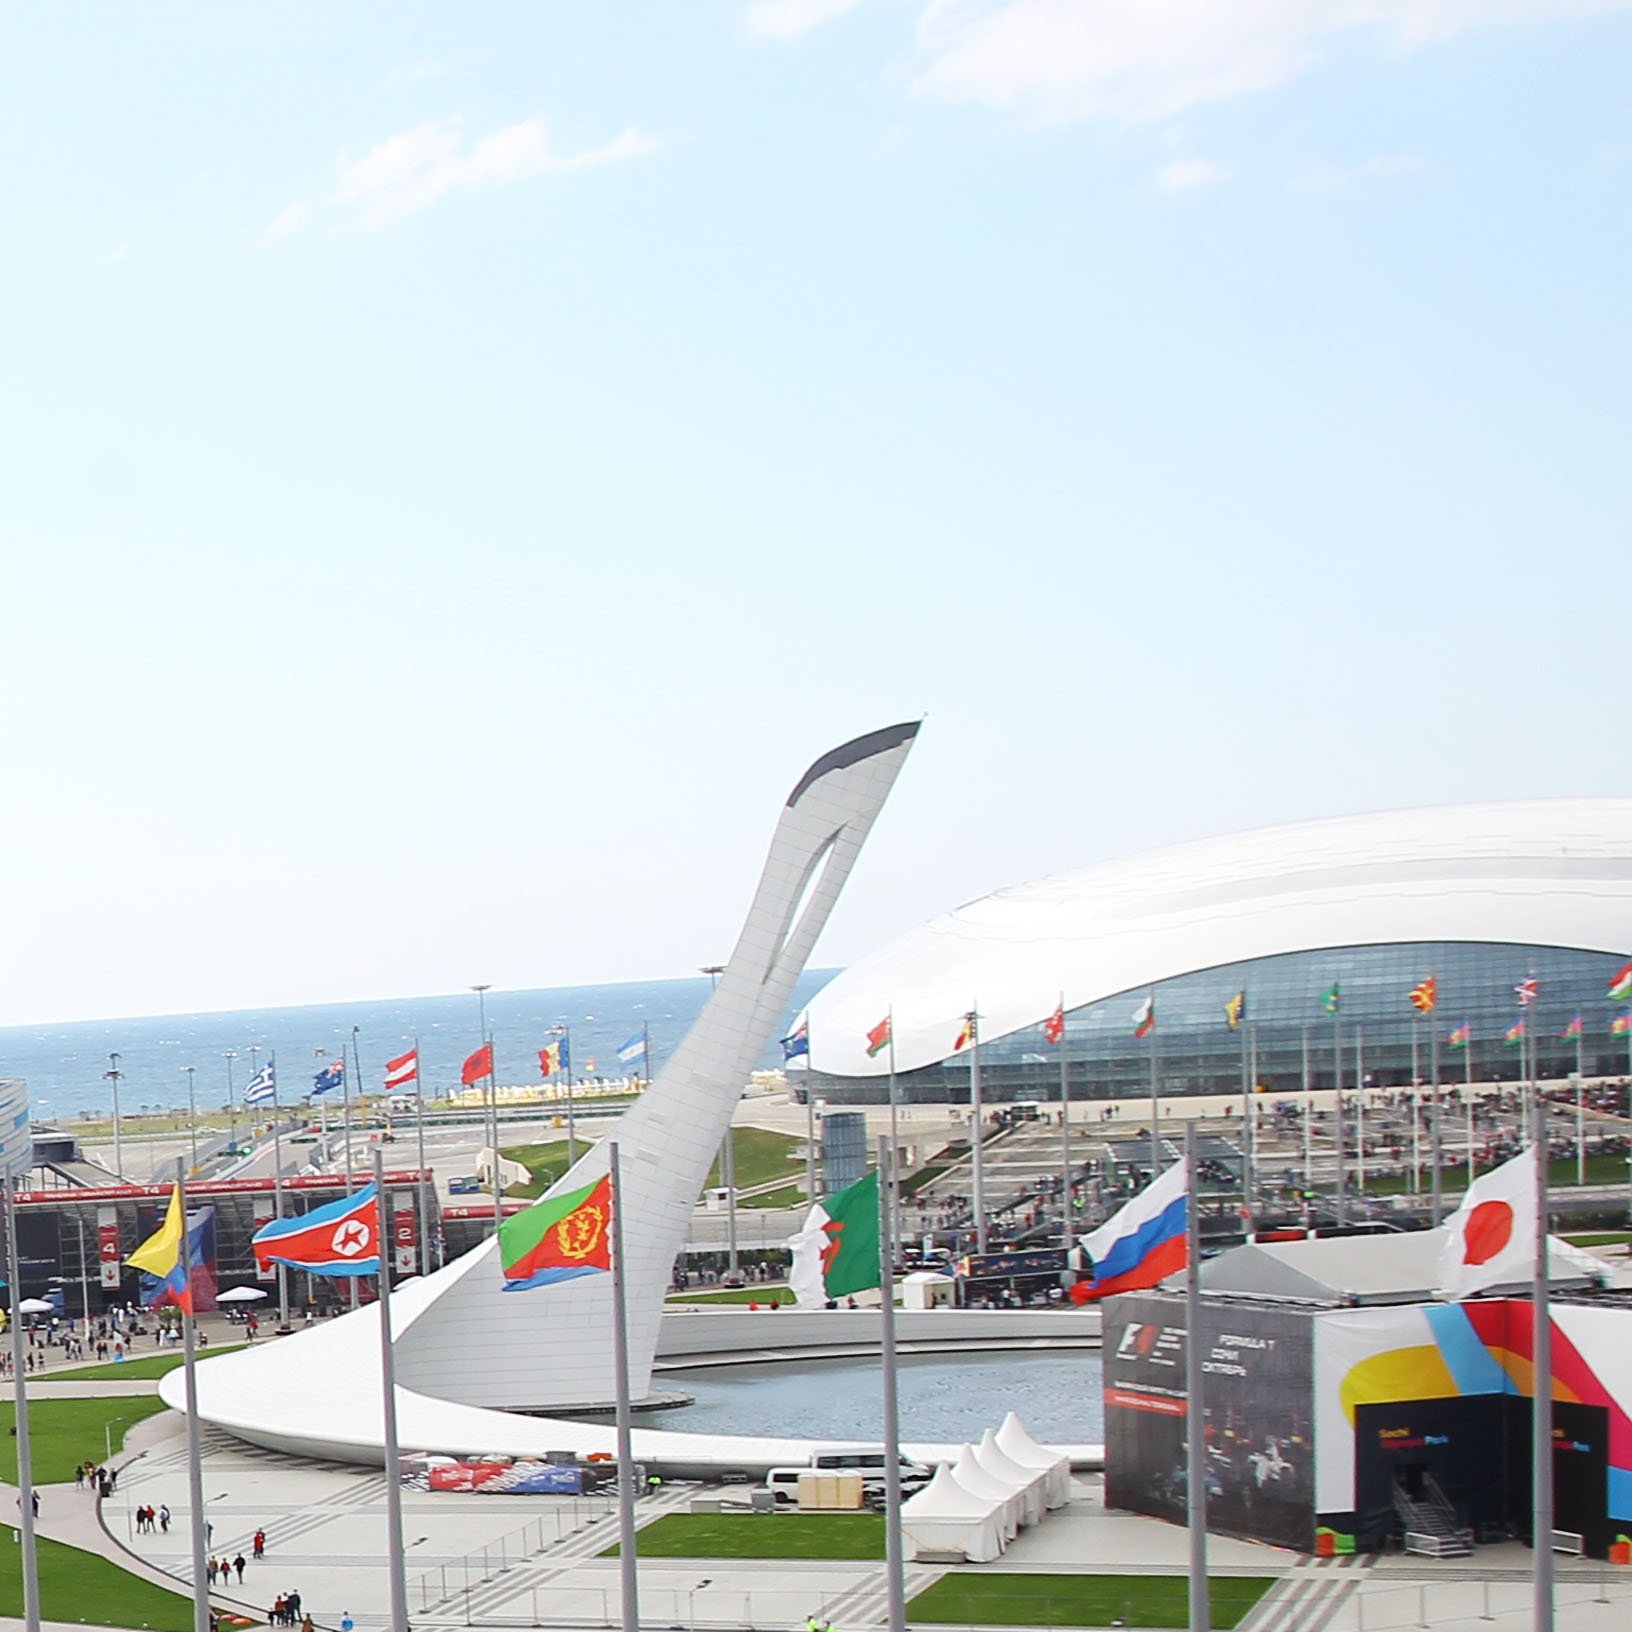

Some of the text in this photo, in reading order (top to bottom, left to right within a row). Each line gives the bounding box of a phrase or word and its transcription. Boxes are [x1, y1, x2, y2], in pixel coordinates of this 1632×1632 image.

[142, 1187, 160, 1196] T4
[14, 1193, 31, 1203] T4
[450, 1208, 468, 1217] T4
[399, 1228, 411, 1239] 2
[103, 1242, 115, 1254] 4
